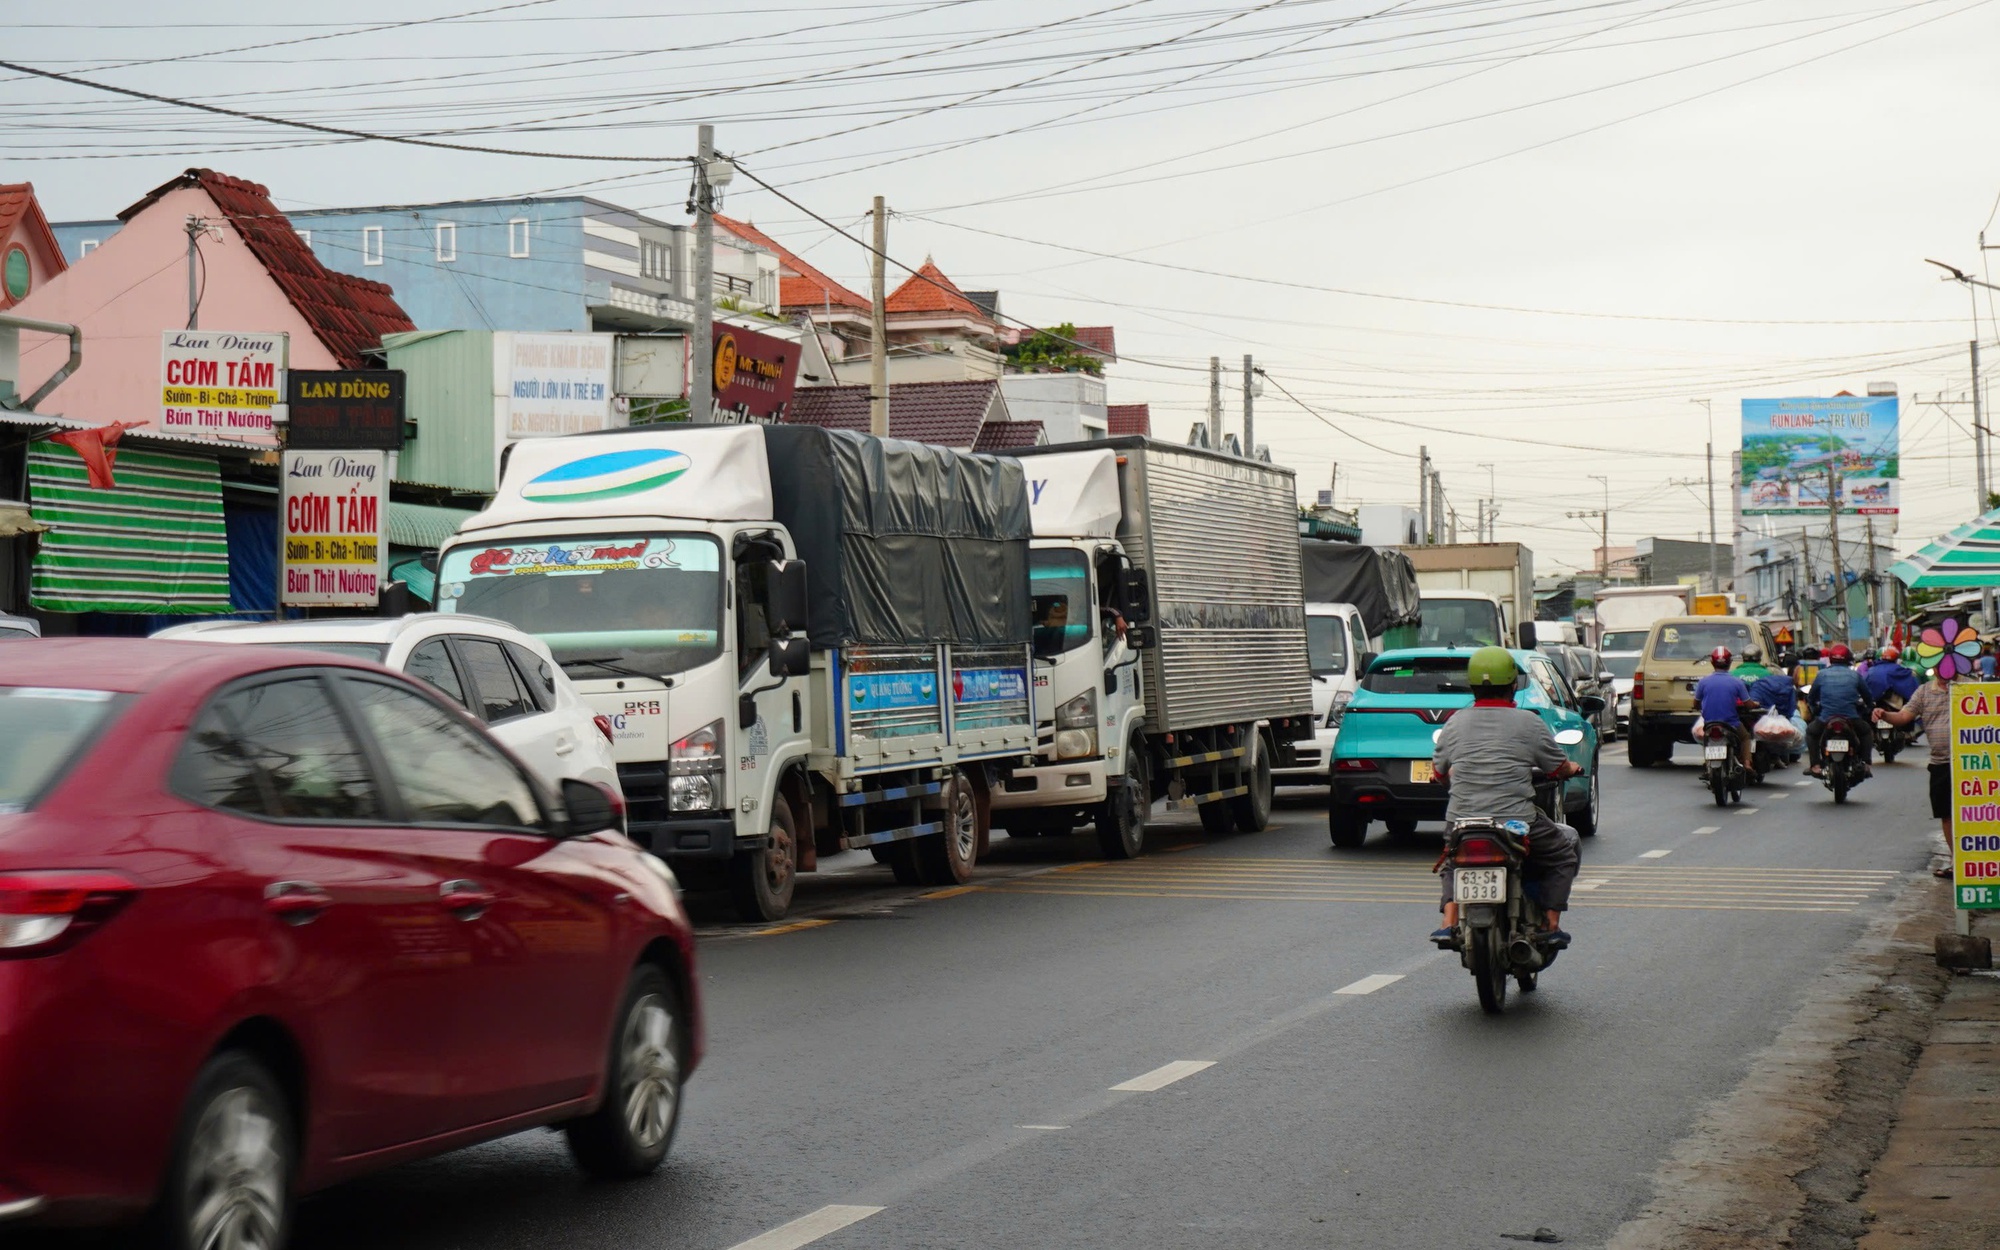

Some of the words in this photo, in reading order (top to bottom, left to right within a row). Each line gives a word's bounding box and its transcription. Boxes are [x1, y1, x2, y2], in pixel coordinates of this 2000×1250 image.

[169, 333, 210, 348] Lan
[217, 335, 274, 354] Dũng
[167, 358, 218, 386] CƠM
[226, 353, 275, 388] TẤM
[166, 390, 192, 403] Sườn
[218, 390, 237, 405] Chả
[301, 382, 337, 398] LAN
[340, 379, 391, 399] DŨNG
[514, 377, 540, 399] NGƯỜI
[561, 379, 571, 400] VÀ
[574, 377, 589, 400] TRẺ
[591, 383, 605, 401] EM
[166, 408, 192, 425] Bún
[198, 410, 223, 430] Thịt
[227, 411, 273, 430] Nướng
[1771, 414, 1814, 428] FUNLAND
[289, 456, 324, 478] Lan
[329, 456, 376, 482] Dũng
[288, 492, 330, 533] CƠM
[337, 482, 377, 533] TẤM
[287, 541, 309, 561] Sườn
[330, 539, 347, 560] Chả
[353, 541, 378, 562] Trứng
[288, 569, 309, 593] Bún
[314, 570, 335, 598] Thịt
[339, 569, 376, 596] Nướng
[624, 701, 660, 709] QKR
[624, 708, 661, 716] 210
[1961, 692, 1989, 715] CÀ
[1961, 752, 1992, 770] TRÀ
[1961, 777, 1983, 795] CÀ
[1961, 836, 2000, 851] CHO
[1965, 862, 2000, 880] DỊC
[1463, 886, 1497, 899] 0338
[1962, 887, 1992, 903] ĐT:
